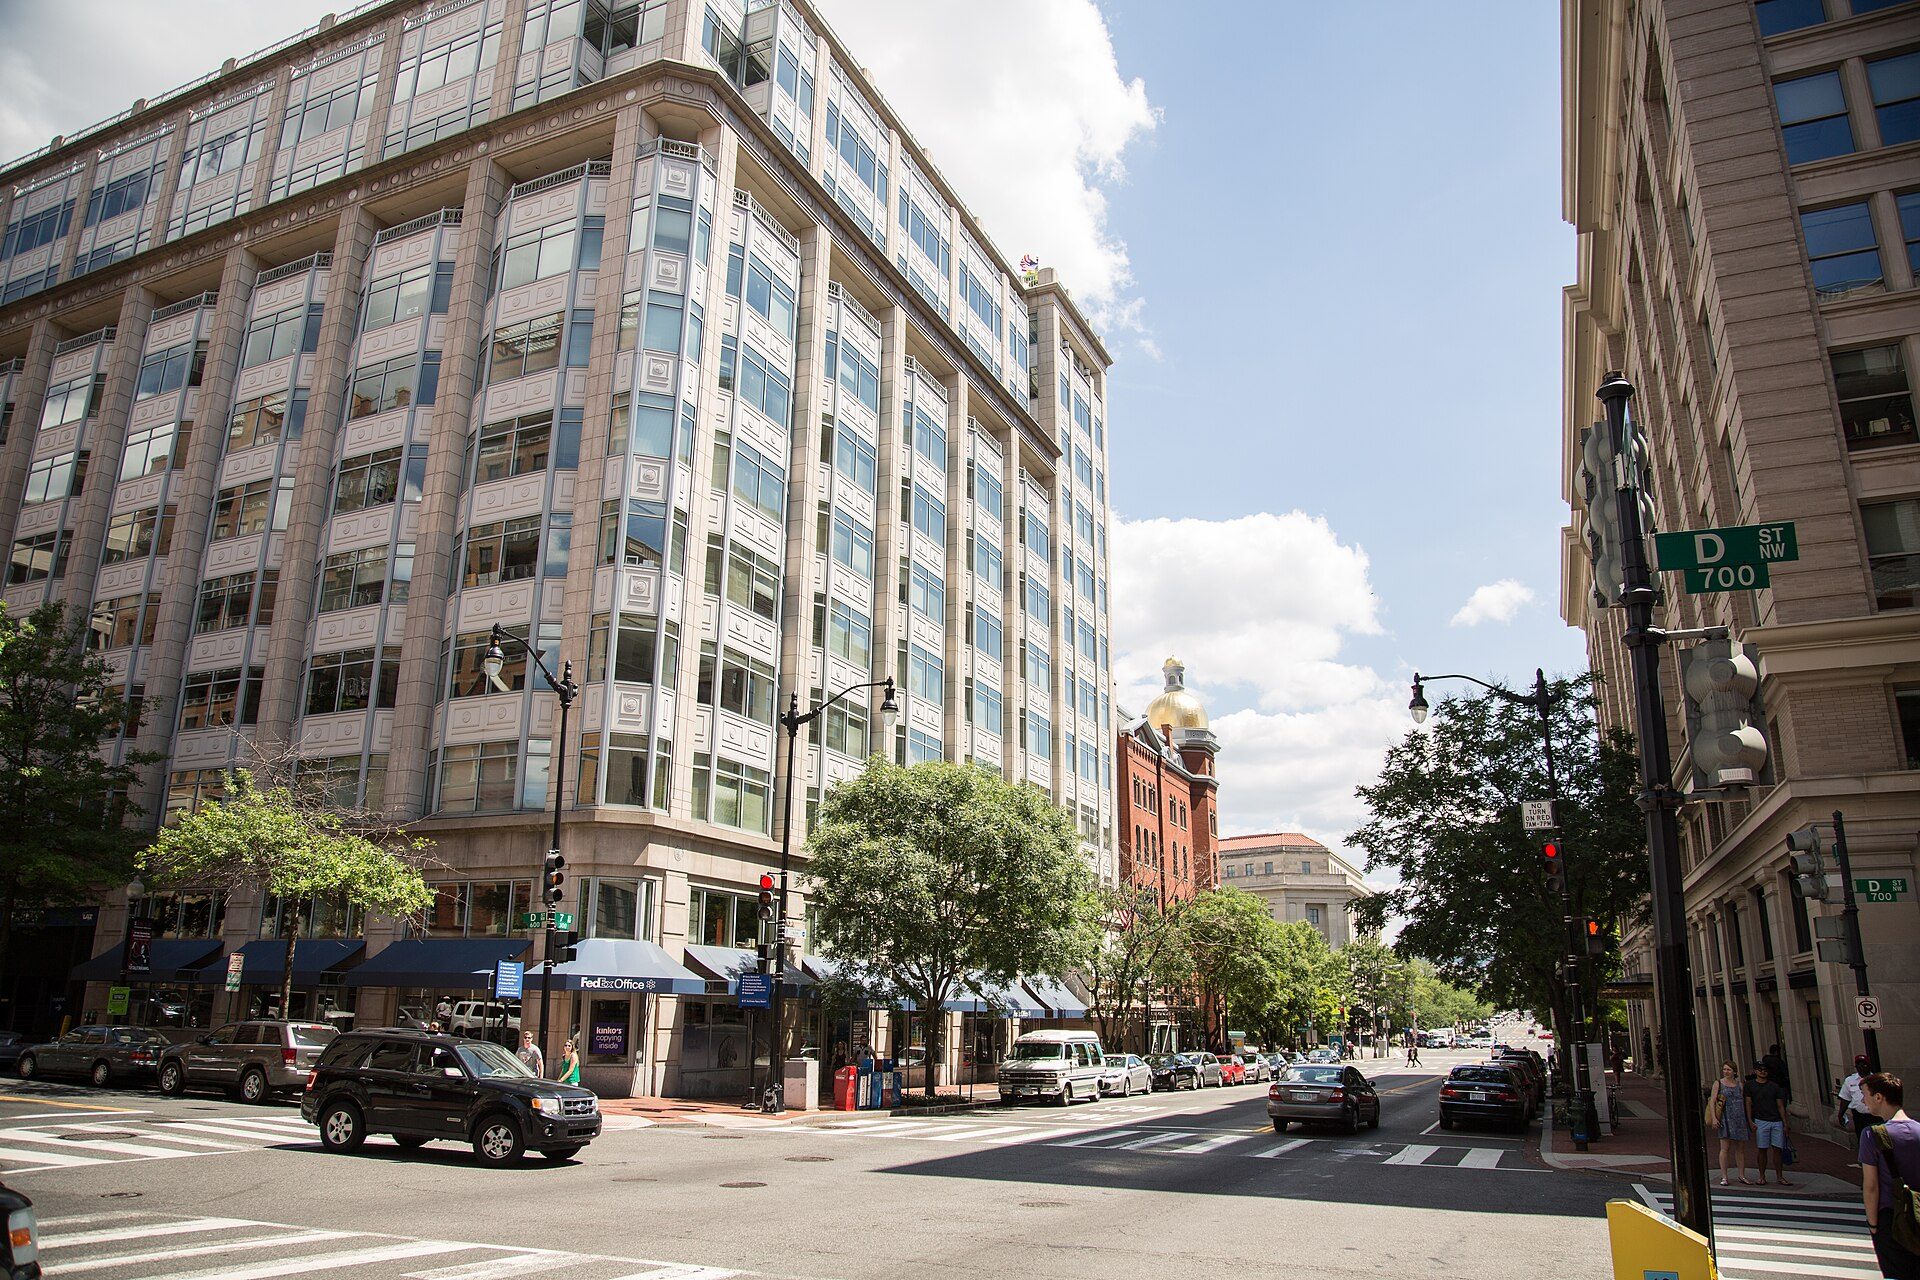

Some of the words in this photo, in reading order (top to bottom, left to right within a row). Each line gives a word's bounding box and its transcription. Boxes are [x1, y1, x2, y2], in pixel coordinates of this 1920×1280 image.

[1694, 533, 1725, 564] D
[1758, 527, 1784, 544] ST
[1759, 543, 1785, 559] NW
[1698, 565, 1755, 589] 700
[1868, 880, 1880, 892] D
[1870, 892, 1892, 901] 700
[530, 913, 537, 922] D
[559, 913, 565, 922] 7
[580, 976, 613, 989] FedEx
[614, 978, 645, 990] Office
[596, 1026, 623, 1034] kinko's
[595, 1034, 622, 1043] copying
[598, 1041, 619, 1050] inside
